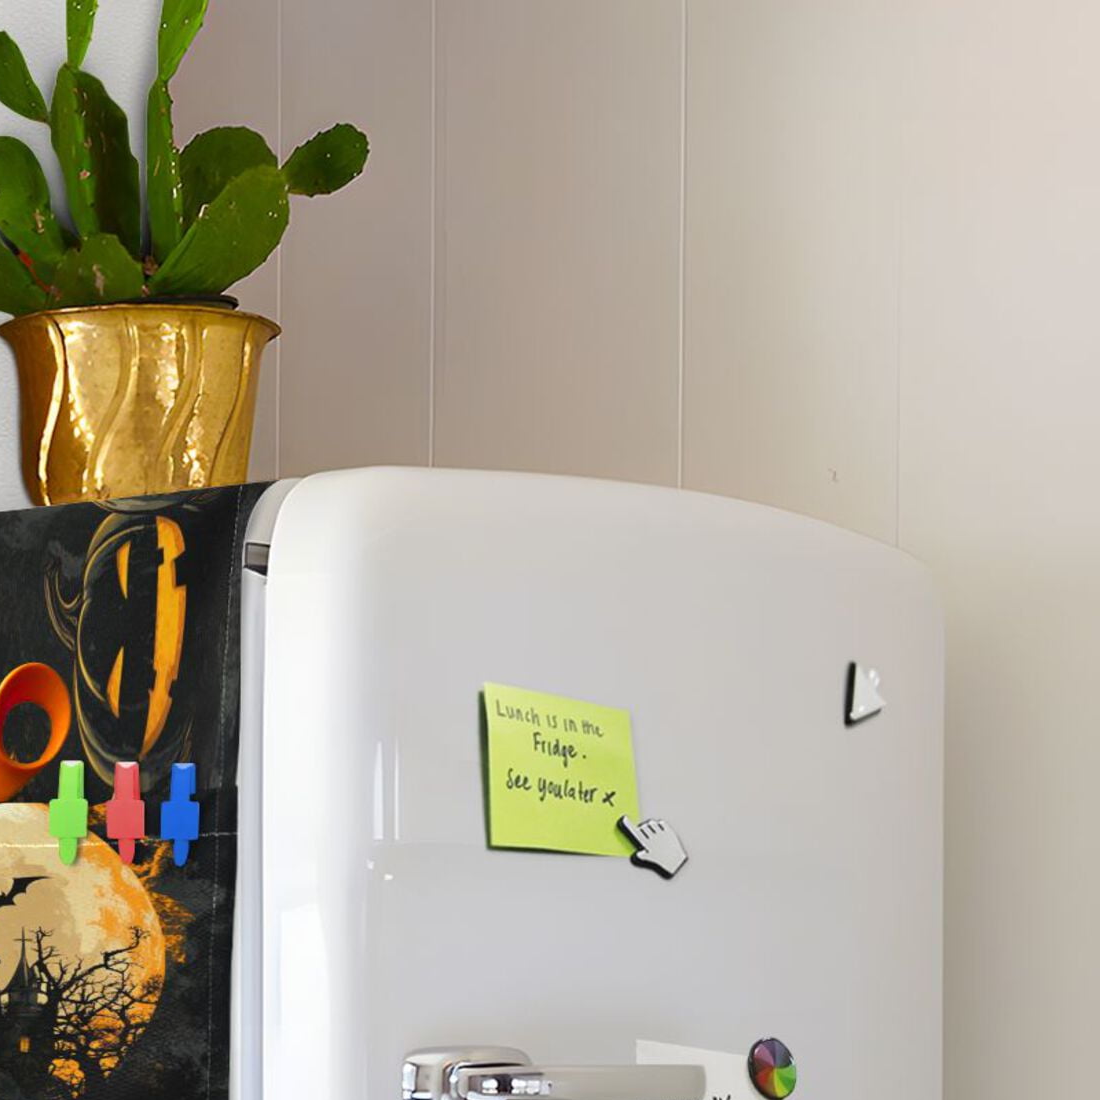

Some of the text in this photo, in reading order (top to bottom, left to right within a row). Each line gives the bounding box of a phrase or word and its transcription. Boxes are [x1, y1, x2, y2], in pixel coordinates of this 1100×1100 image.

[495, 699, 540, 727] Lunch
[563, 718, 578, 733] in
[582, 719, 603, 737] the
[506, 768, 532, 790] See
